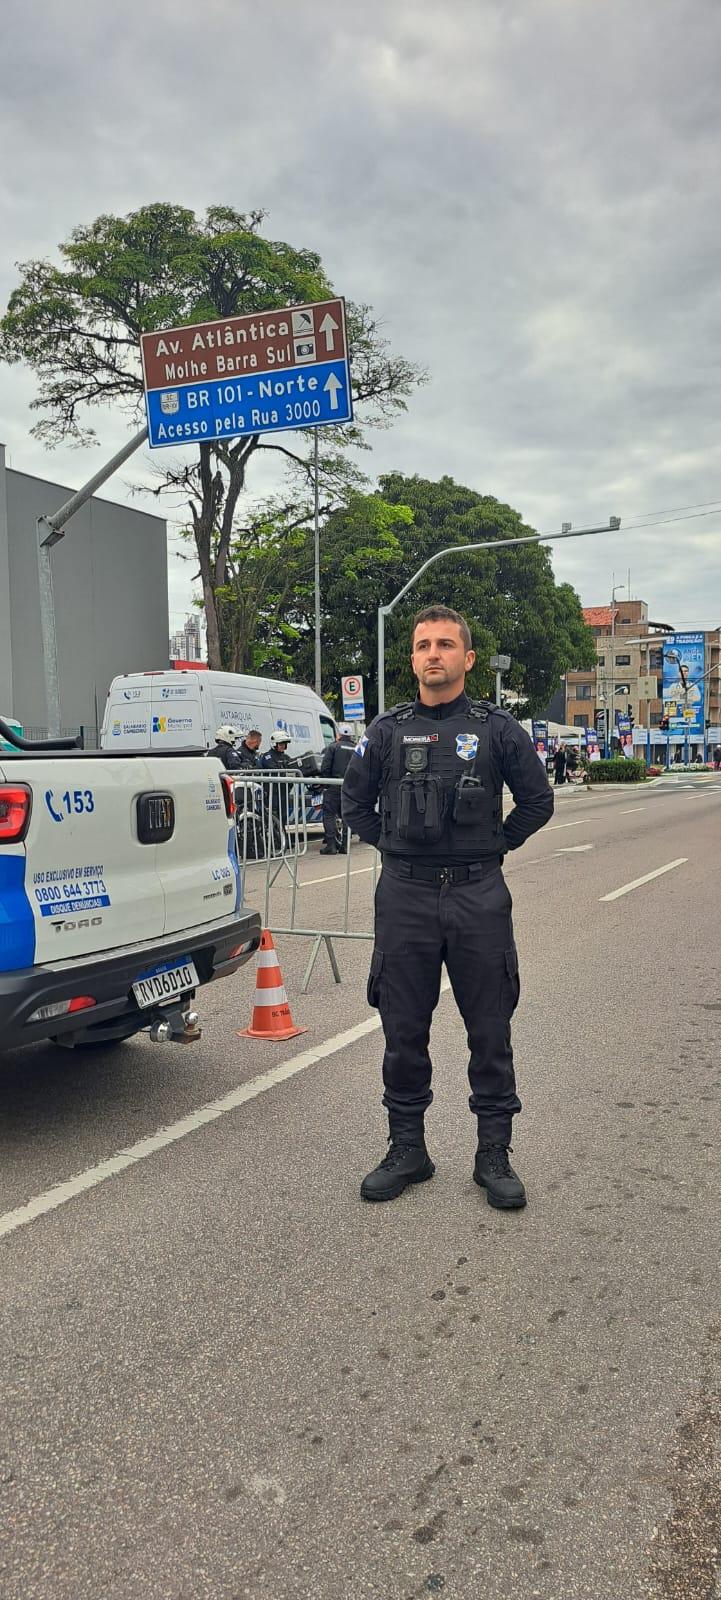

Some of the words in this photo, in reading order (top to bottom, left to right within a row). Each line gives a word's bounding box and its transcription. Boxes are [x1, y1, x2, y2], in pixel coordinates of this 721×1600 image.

[156, 339, 183, 357] Av.
[191, 321, 289, 351] Atlântica
[165, 359, 208, 380] Molhe
[216, 354, 257, 373] Barra
[266, 344, 291, 364] Sul
[187, 391, 210, 409] BR
[217, 385, 242, 405] 101
[259, 375, 318, 398] Norte
[158, 420, 208, 439] Acesso
[215, 413, 245, 435] pela
[251, 408, 279, 426] Rua
[285, 400, 321, 421] 3000
[349, 681, 356, 692] E
[63, 790, 94, 814] 153
[148, 799, 171, 829] FIAT
[33, 871, 45, 884] USO
[45, 868, 75, 882] EXCLUSIVO
[75, 867, 83, 879] EM
[83, 865, 104, 878] SERVIÇO
[34, 886, 61, 902] 0800
[62, 883, 82, 898] 644
[82, 879, 107, 895] 3773
[50, 903, 72, 914] DISQUE
[71, 898, 102, 911] DENÚNCIAS!
[138, 966, 193, 1002] RYD6D10
